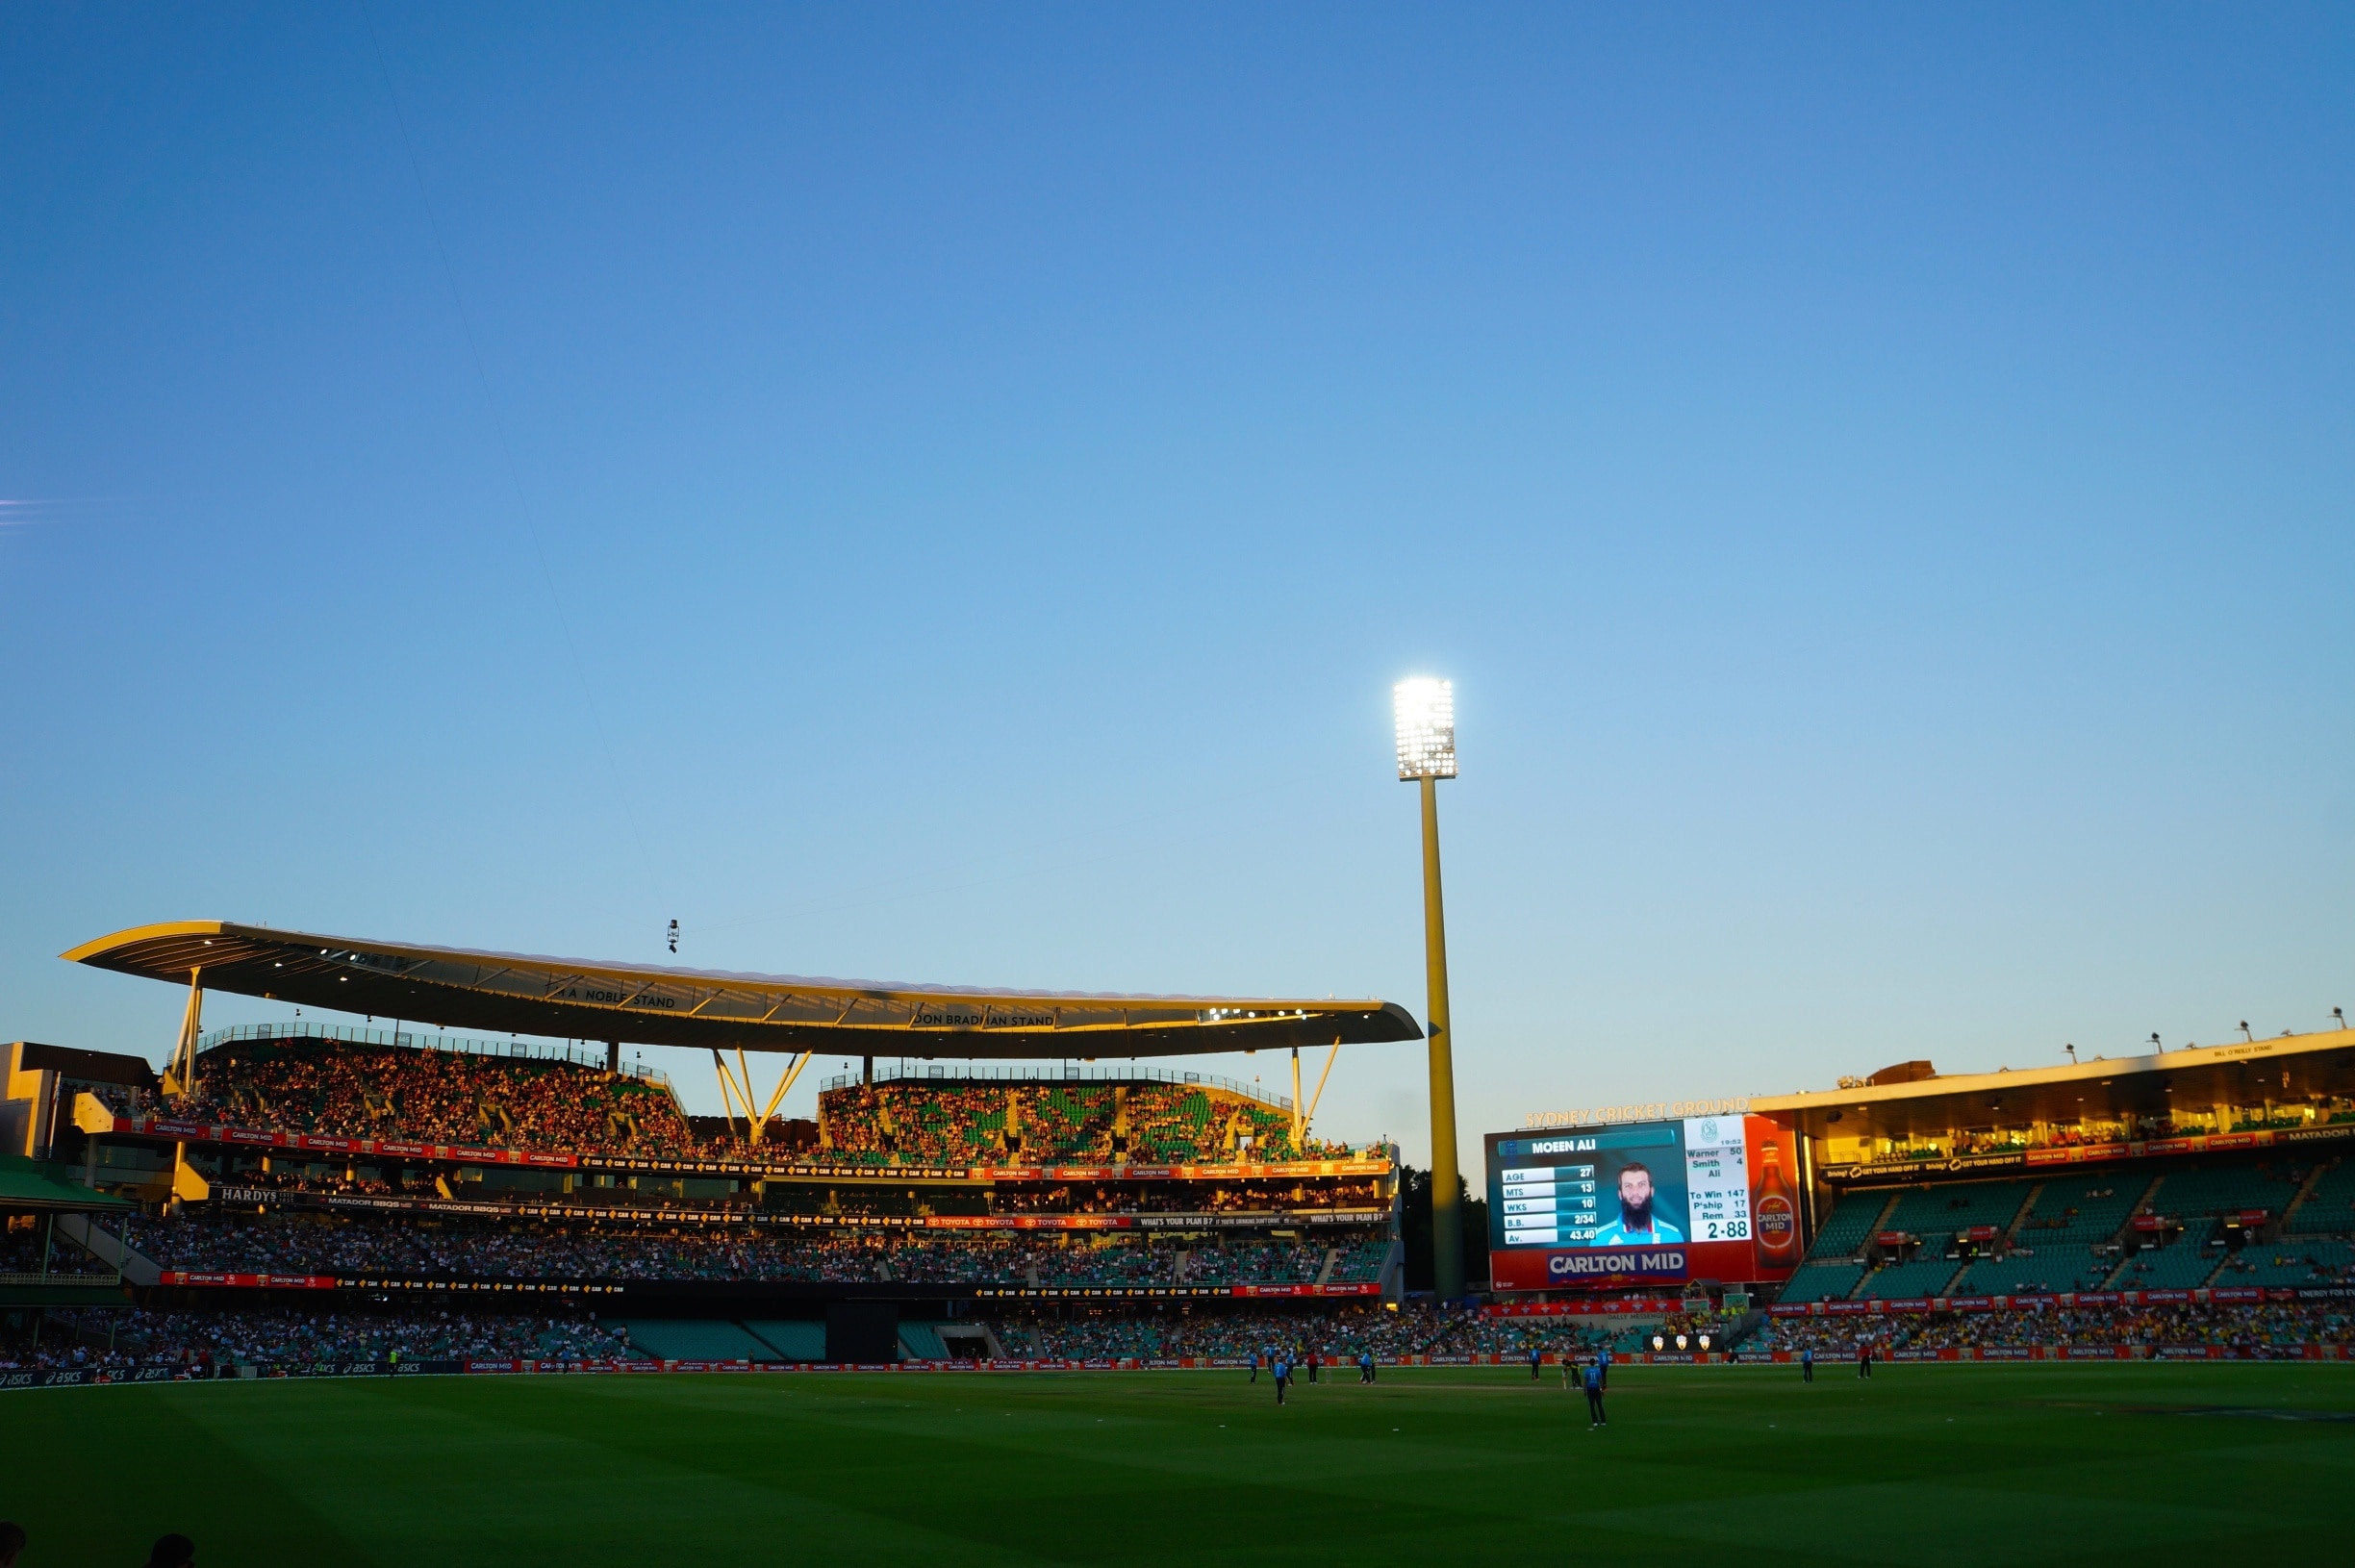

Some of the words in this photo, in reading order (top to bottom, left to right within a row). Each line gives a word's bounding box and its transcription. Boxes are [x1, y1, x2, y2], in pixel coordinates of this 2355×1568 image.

[569, 989, 576, 998] A
[634, 995, 675, 1008] STAND
[1012, 1017, 1053, 1026] STAND
[1526, 1109, 1590, 1126] SYDNEY
[1596, 1103, 1667, 1122] CRICKET
[1672, 1097, 1749, 1116] GROUND
[155, 1124, 182, 1133] CARLTON
[232, 1131, 258, 1139] CARLTON
[2289, 1129, 2350, 1141] MATADOR
[1532, 1141, 1575, 1154] MOEEN
[1577, 1139, 1596, 1151] ALI
[1693, 1160, 1720, 1168] Smith
[1580, 1168, 1591, 1177] 27
[1581, 1184, 1592, 1192] 13
[328, 1197, 371, 1206] MATADOR
[1582, 1199, 1593, 1208] 10
[1694, 1202, 1722, 1210] P'ship
[1575, 1215, 1594, 1224] 2/34
[1758, 1213, 1792, 1222] CARLTON
[1570, 1231, 1594, 1240] 43.40
[1550, 1255, 1635, 1274] CARLTON
[1642, 1253, 1684, 1271] MID
